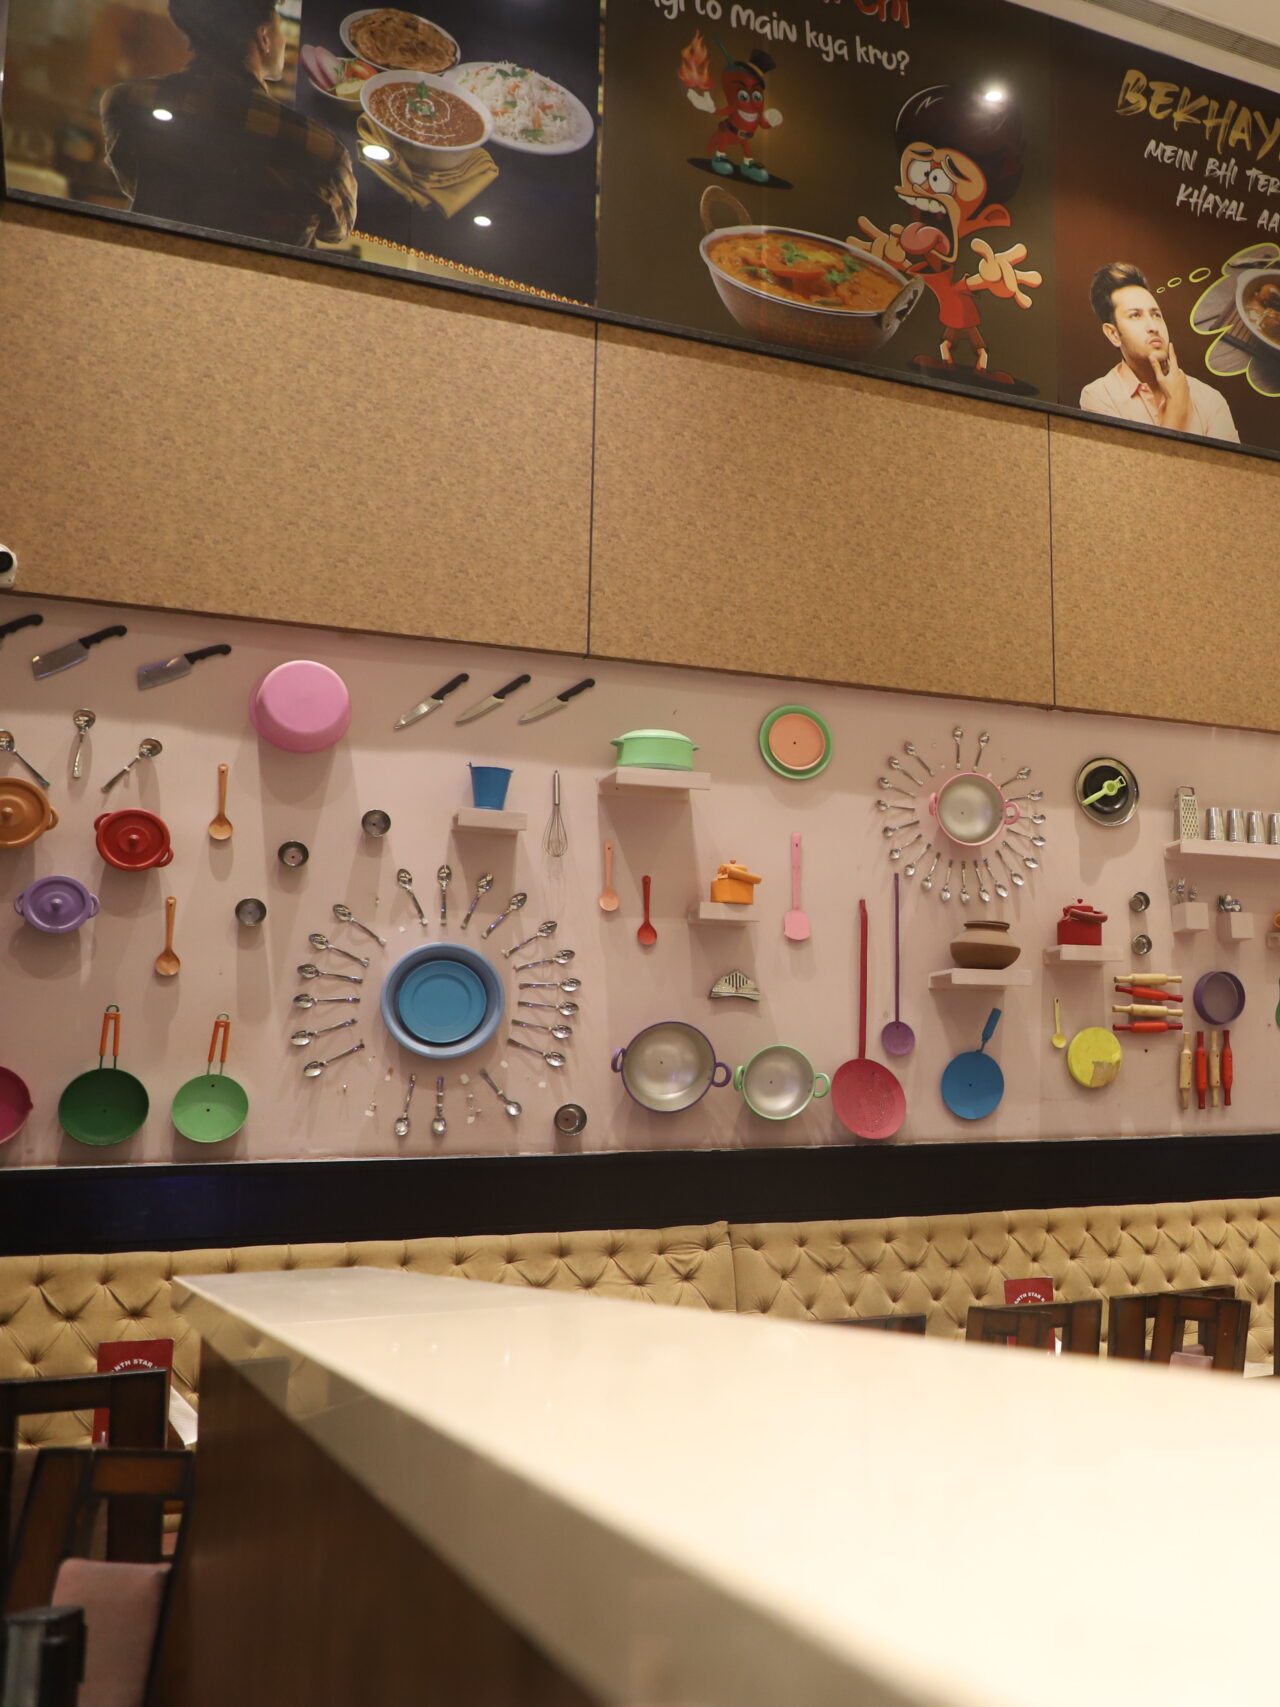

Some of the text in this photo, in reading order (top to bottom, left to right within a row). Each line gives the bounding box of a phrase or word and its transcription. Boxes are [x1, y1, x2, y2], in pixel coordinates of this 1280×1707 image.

[805, 20, 849, 62] kya
[855, 36, 910, 75] kru?
[1144, 138, 1197, 171] MEIN
[1204, 157, 1238, 189] BHI
[1176, 183, 1248, 222] KHAYAL
[111, 1358, 154, 1372] NTH STAR
